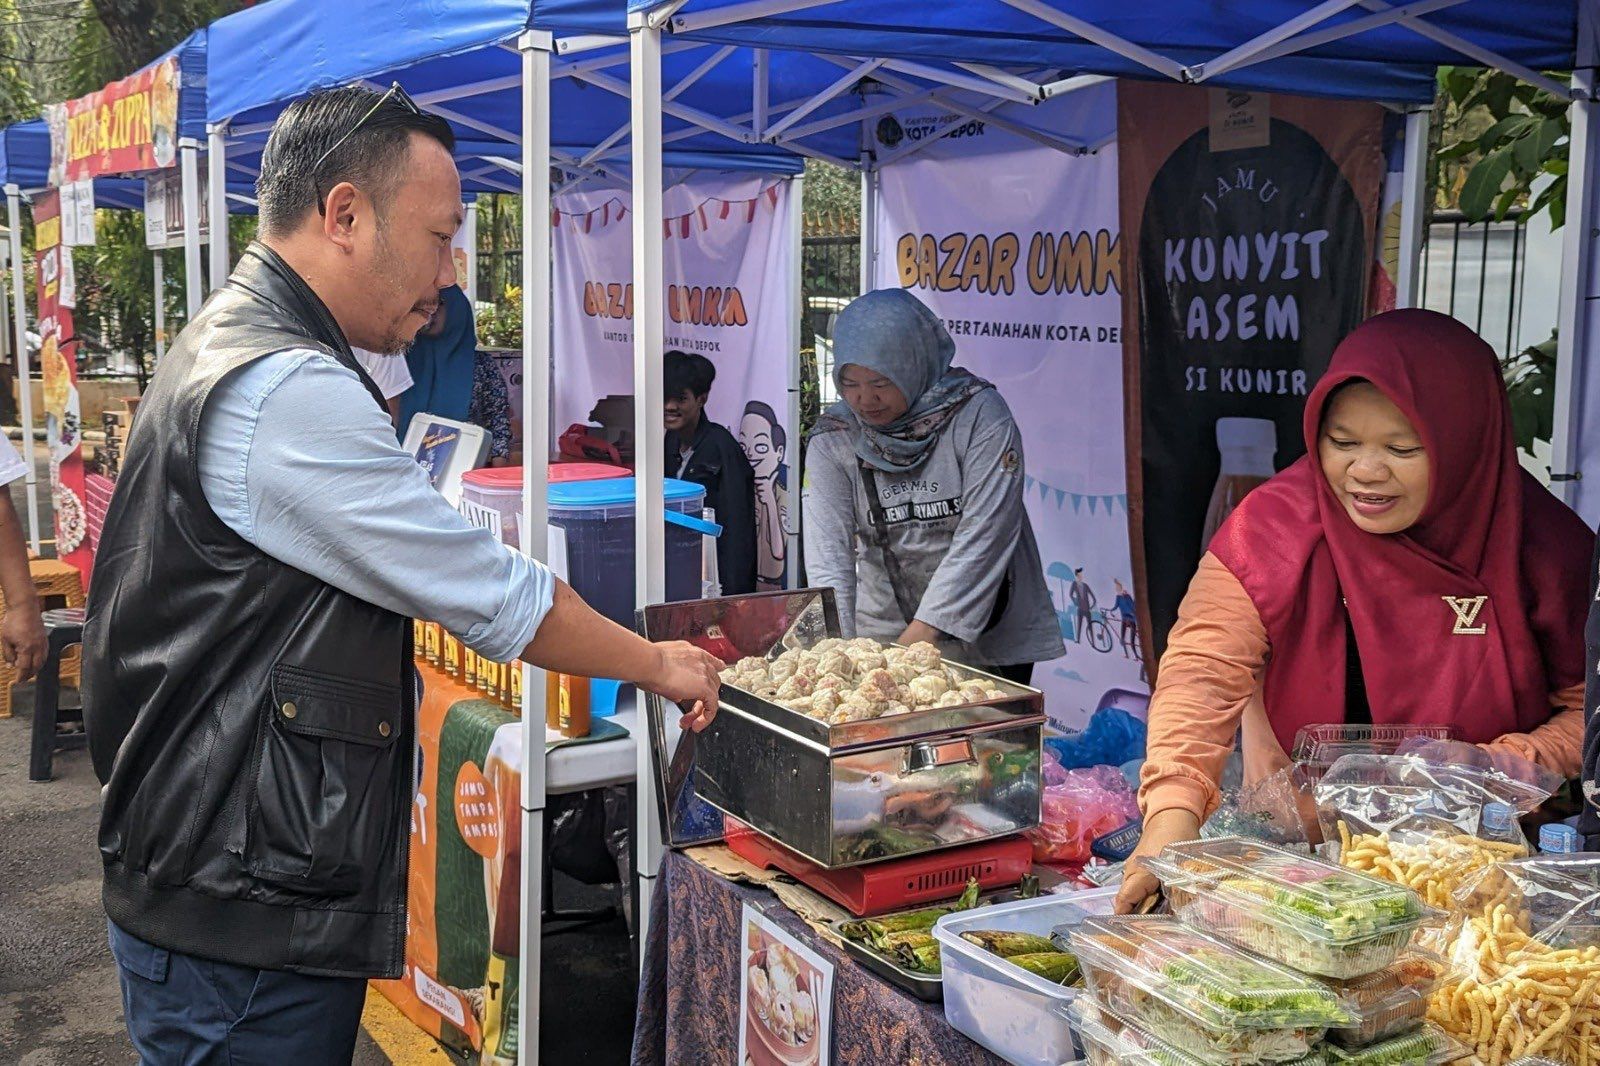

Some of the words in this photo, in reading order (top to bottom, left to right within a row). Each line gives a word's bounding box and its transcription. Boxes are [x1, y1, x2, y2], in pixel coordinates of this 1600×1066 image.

[1203, 168, 1279, 212] JAMU
[897, 232, 1020, 296] BAZAR
[1027, 228, 1121, 297] UMK
[1164, 229, 1330, 283] KUNYIT
[948, 319, 1042, 340] PERTANAHAN
[1046, 325, 1091, 342] KOTA
[1186, 293, 1300, 342] ASEM
[695, 341, 721, 352] DEPOK
[1185, 366, 1208, 392] SI
[1220, 367, 1308, 396] KUNIR
[882, 480, 939, 500] GERMAS
[459, 802, 495, 818] TANPA
[464, 822, 498, 838] AMPAS
